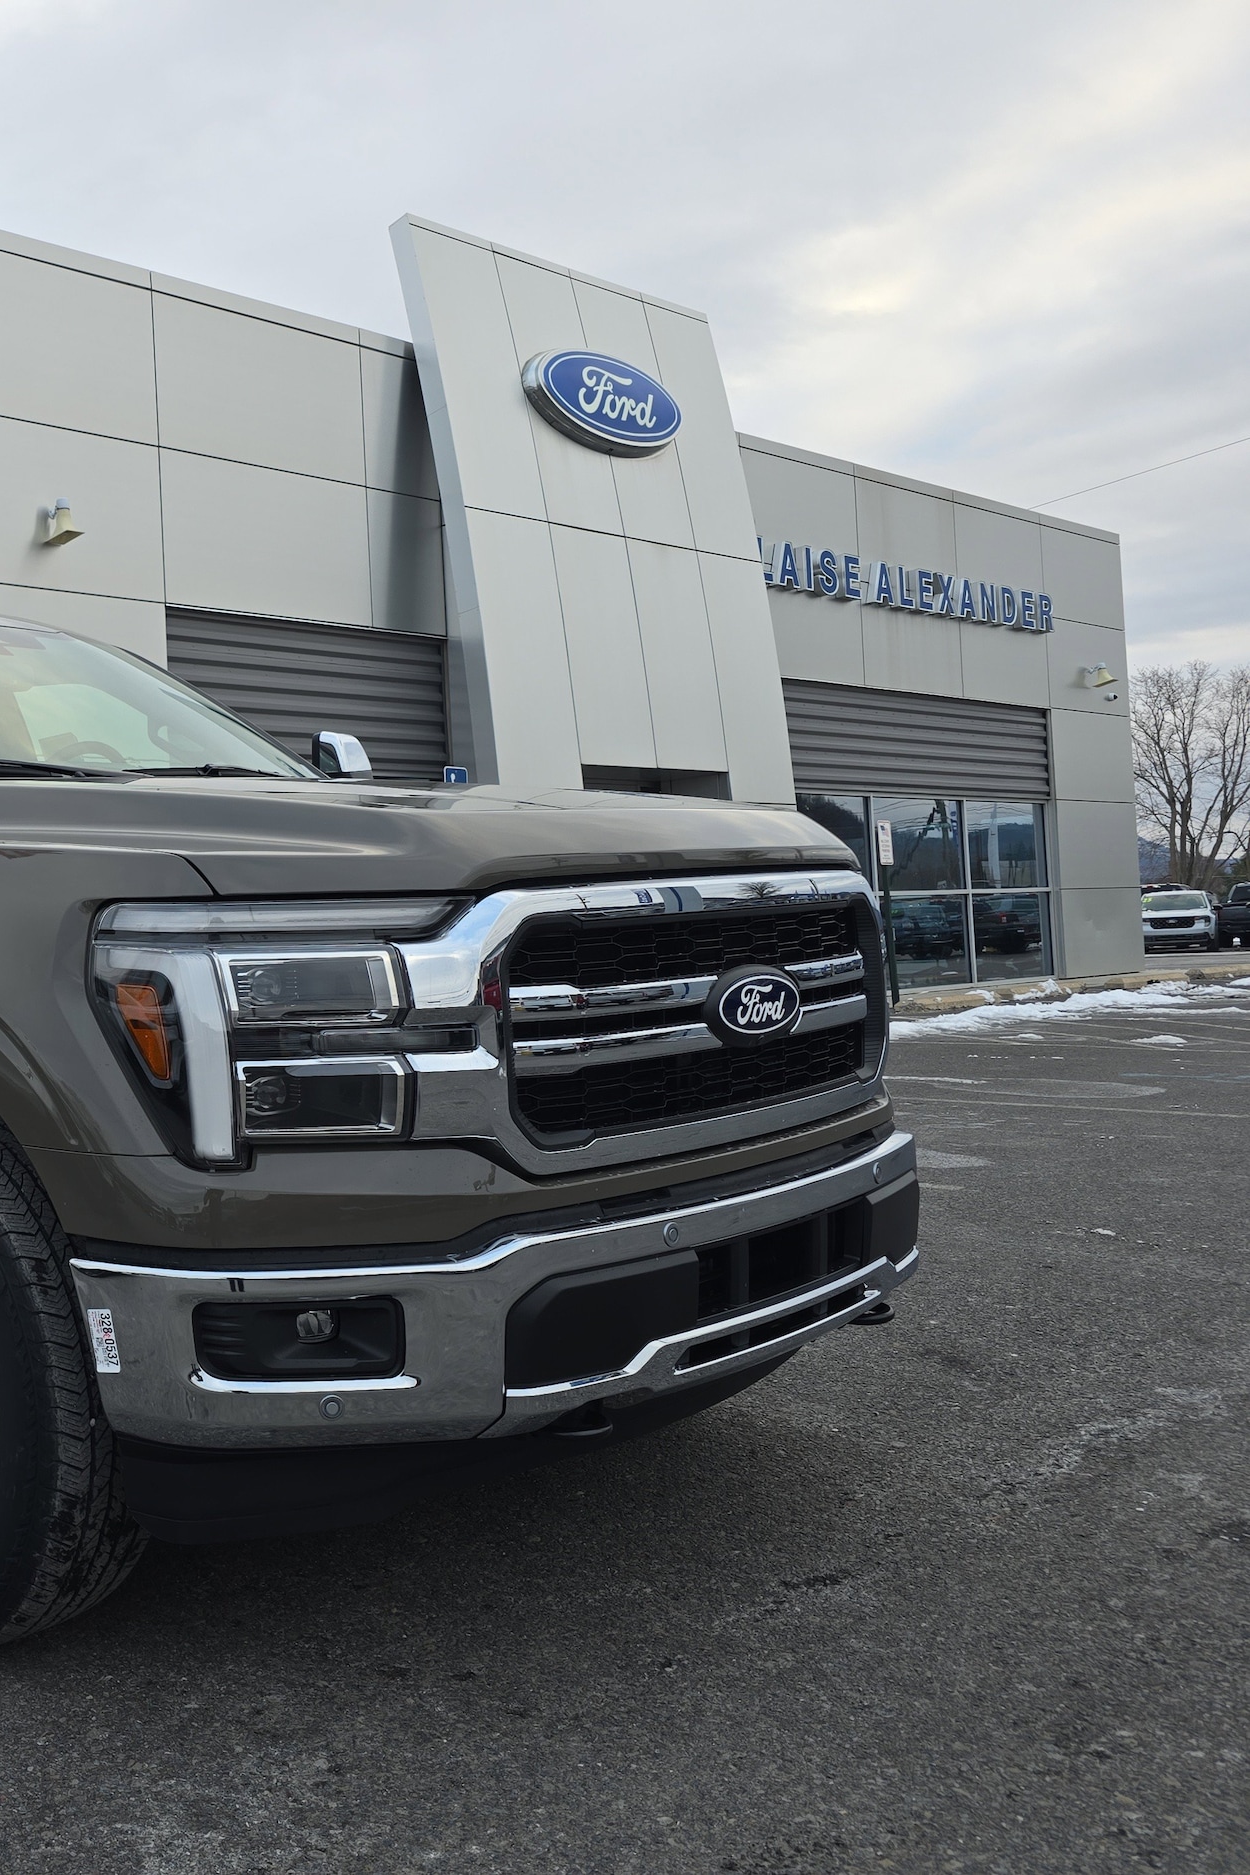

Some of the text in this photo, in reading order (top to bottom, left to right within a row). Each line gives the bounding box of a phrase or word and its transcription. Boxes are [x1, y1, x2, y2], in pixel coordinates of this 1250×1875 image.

[578, 365, 656, 428] Ford
[873, 561, 1054, 632] ALEXANDER
[737, 984, 785, 1025] Ford
